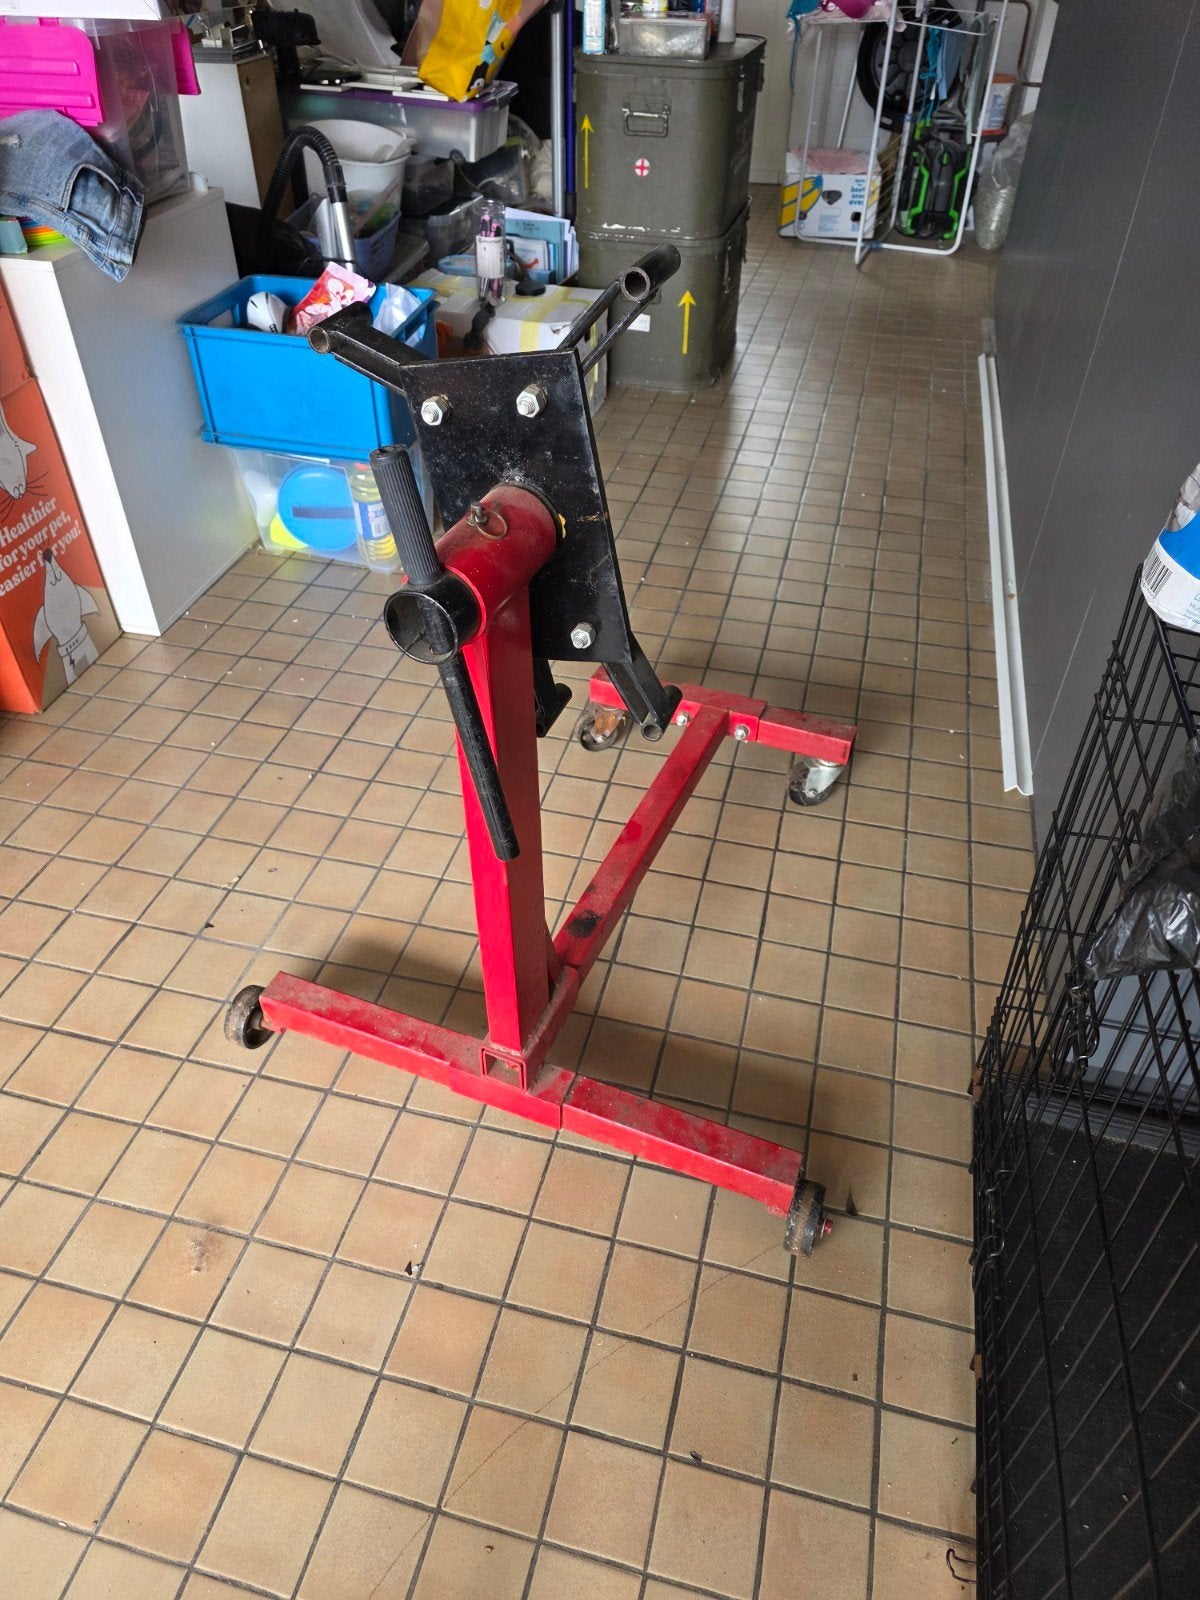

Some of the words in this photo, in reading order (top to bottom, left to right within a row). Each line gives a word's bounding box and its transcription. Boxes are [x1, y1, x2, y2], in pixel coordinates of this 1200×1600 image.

[0, 497, 57, 548] Healthier
[18, 526, 48, 561] your
[49, 510, 71, 538] pet,
[0, 560, 36, 597] easier
[37, 543, 58, 567] fr
[58, 519, 81, 555] you!
